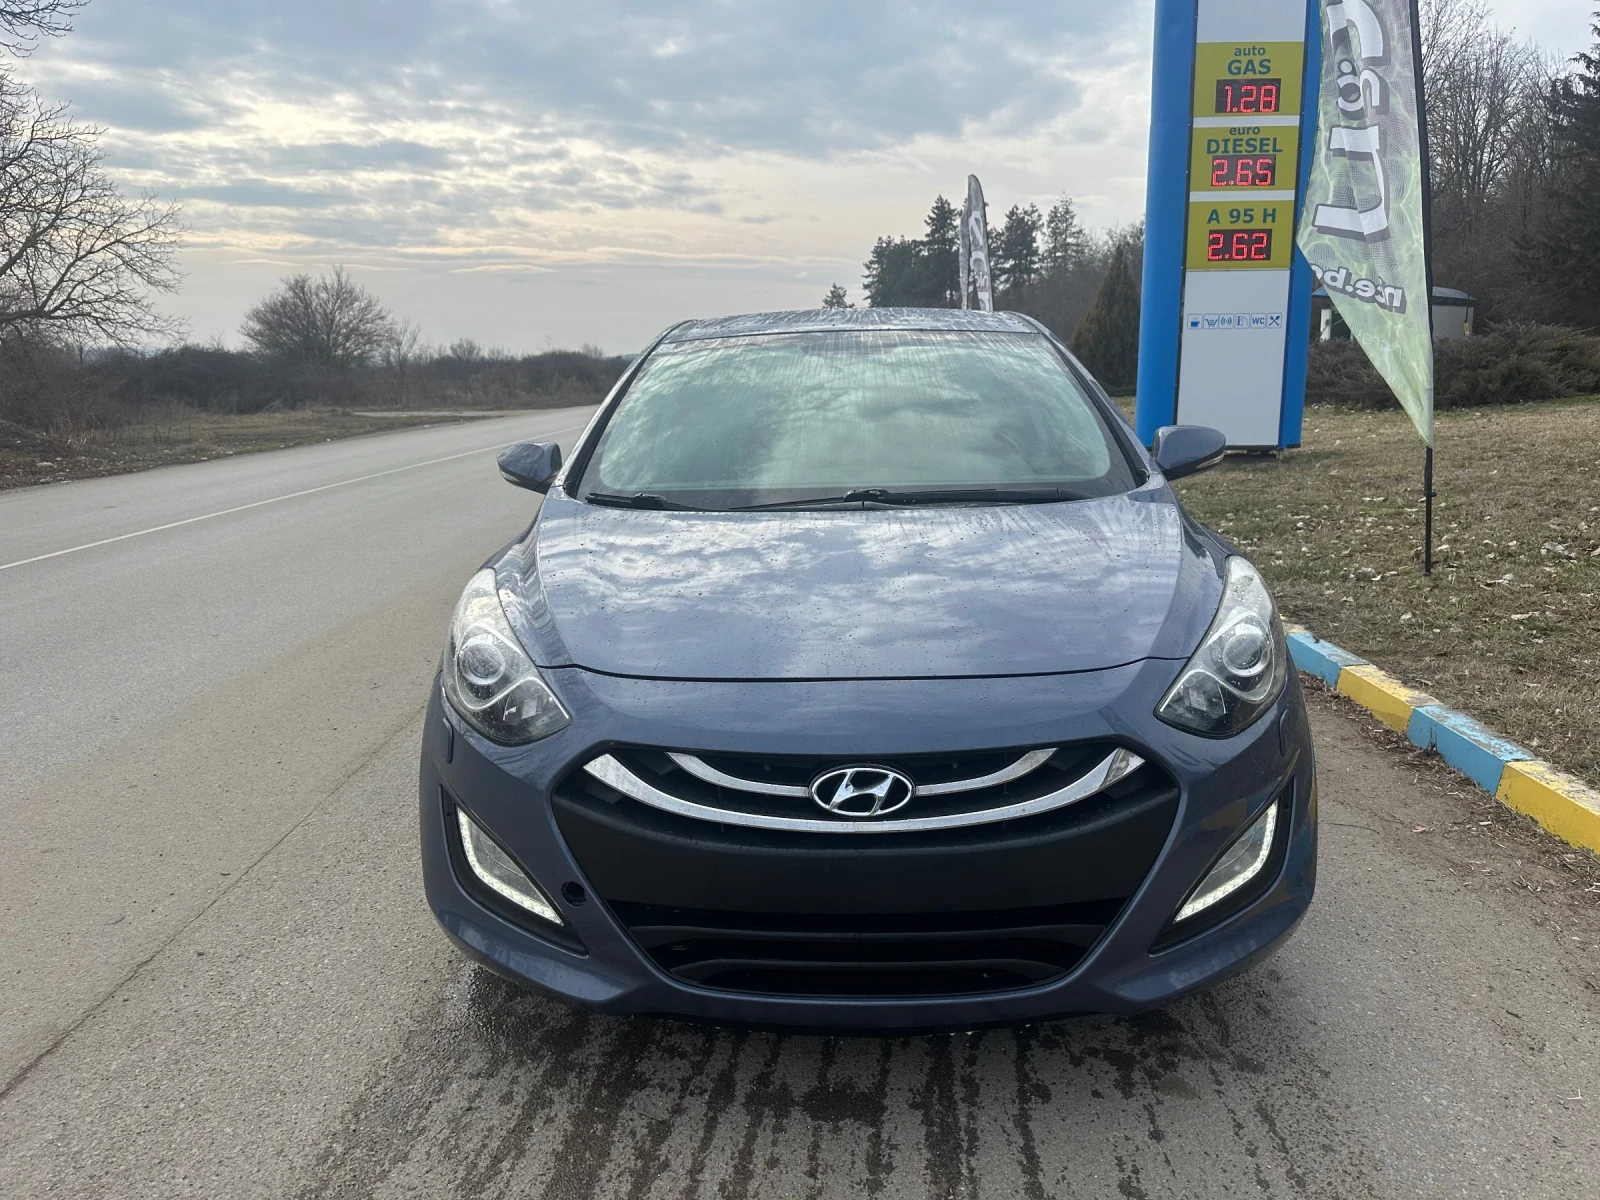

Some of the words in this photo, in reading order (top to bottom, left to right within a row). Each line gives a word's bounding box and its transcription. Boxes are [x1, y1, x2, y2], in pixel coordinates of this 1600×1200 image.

[1234, 46, 1266, 56] auto
[1227, 59, 1271, 75] GAS
[1224, 85, 1276, 112] 1.28
[1229, 126, 1260, 135] euro
[1206, 137, 1283, 154] DIESEL
[1212, 158, 1272, 186] 2.65
[1207, 208, 1221, 224] A
[1228, 208, 1254, 224] 95
[1262, 208, 1276, 223] H
[1208, 232, 1267, 260] 2.62
[1252, 317, 1265, 325] WC
